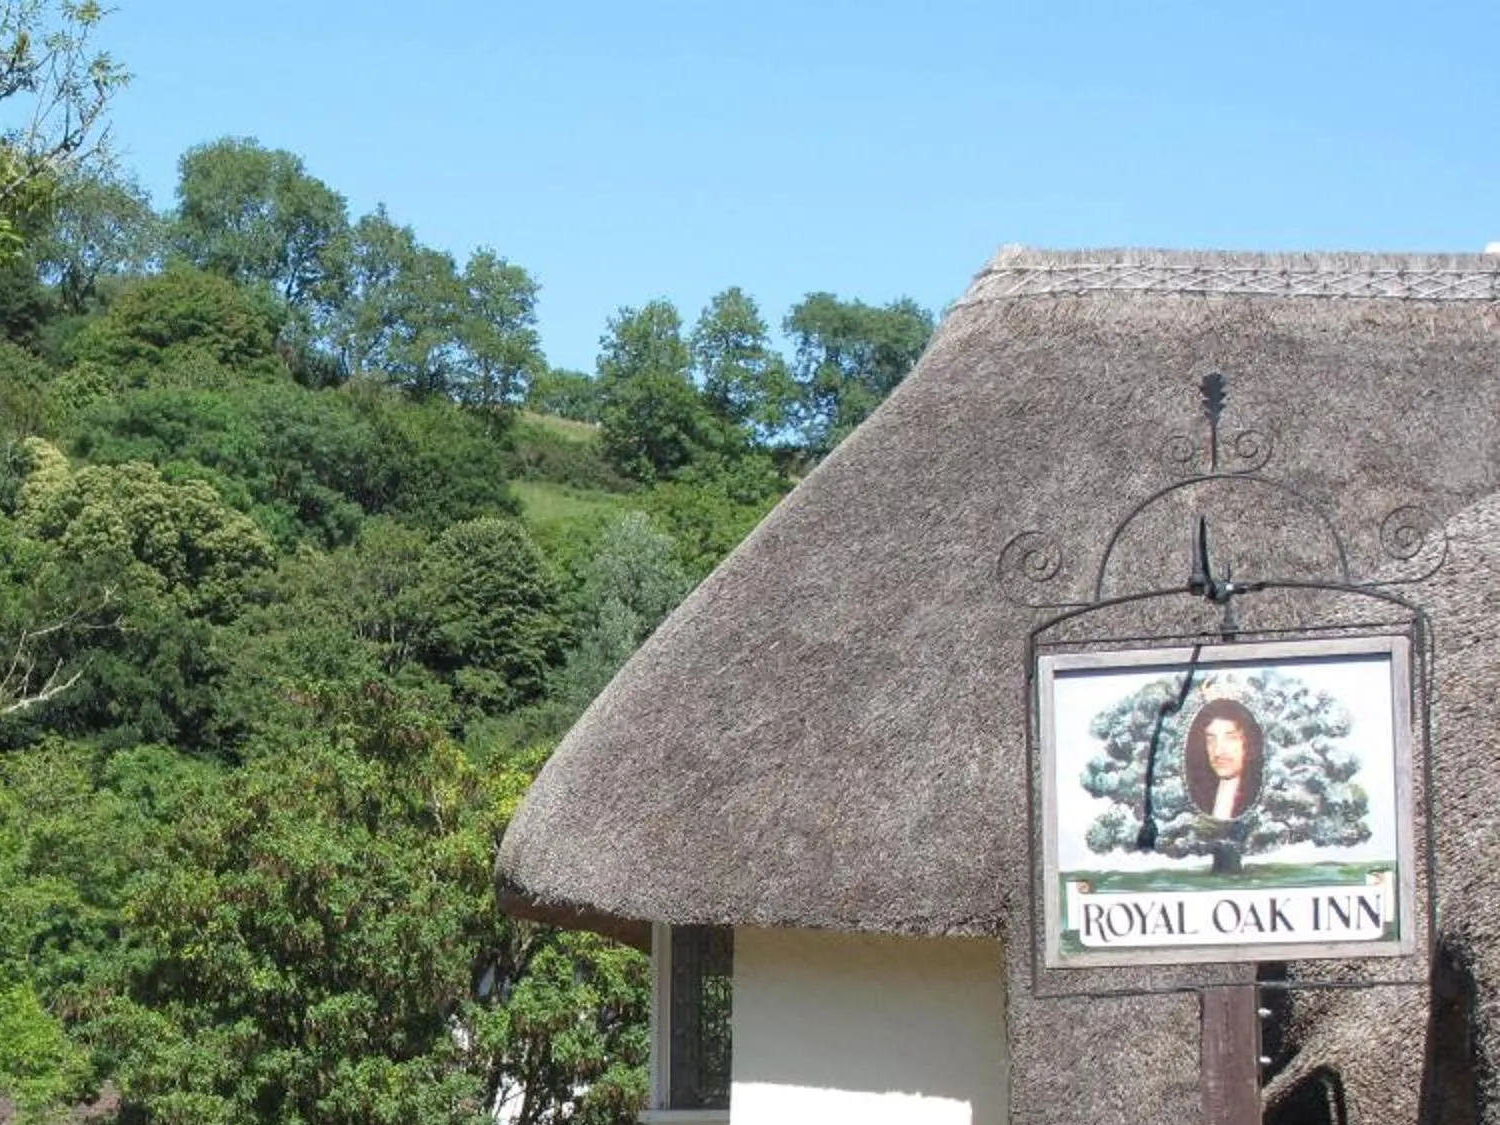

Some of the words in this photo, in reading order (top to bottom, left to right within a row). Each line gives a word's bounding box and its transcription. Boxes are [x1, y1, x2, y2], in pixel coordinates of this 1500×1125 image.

[1083, 901, 1198, 942] ROYAL
[1212, 898, 1295, 934] OAK
[1311, 894, 1381, 932] INN
